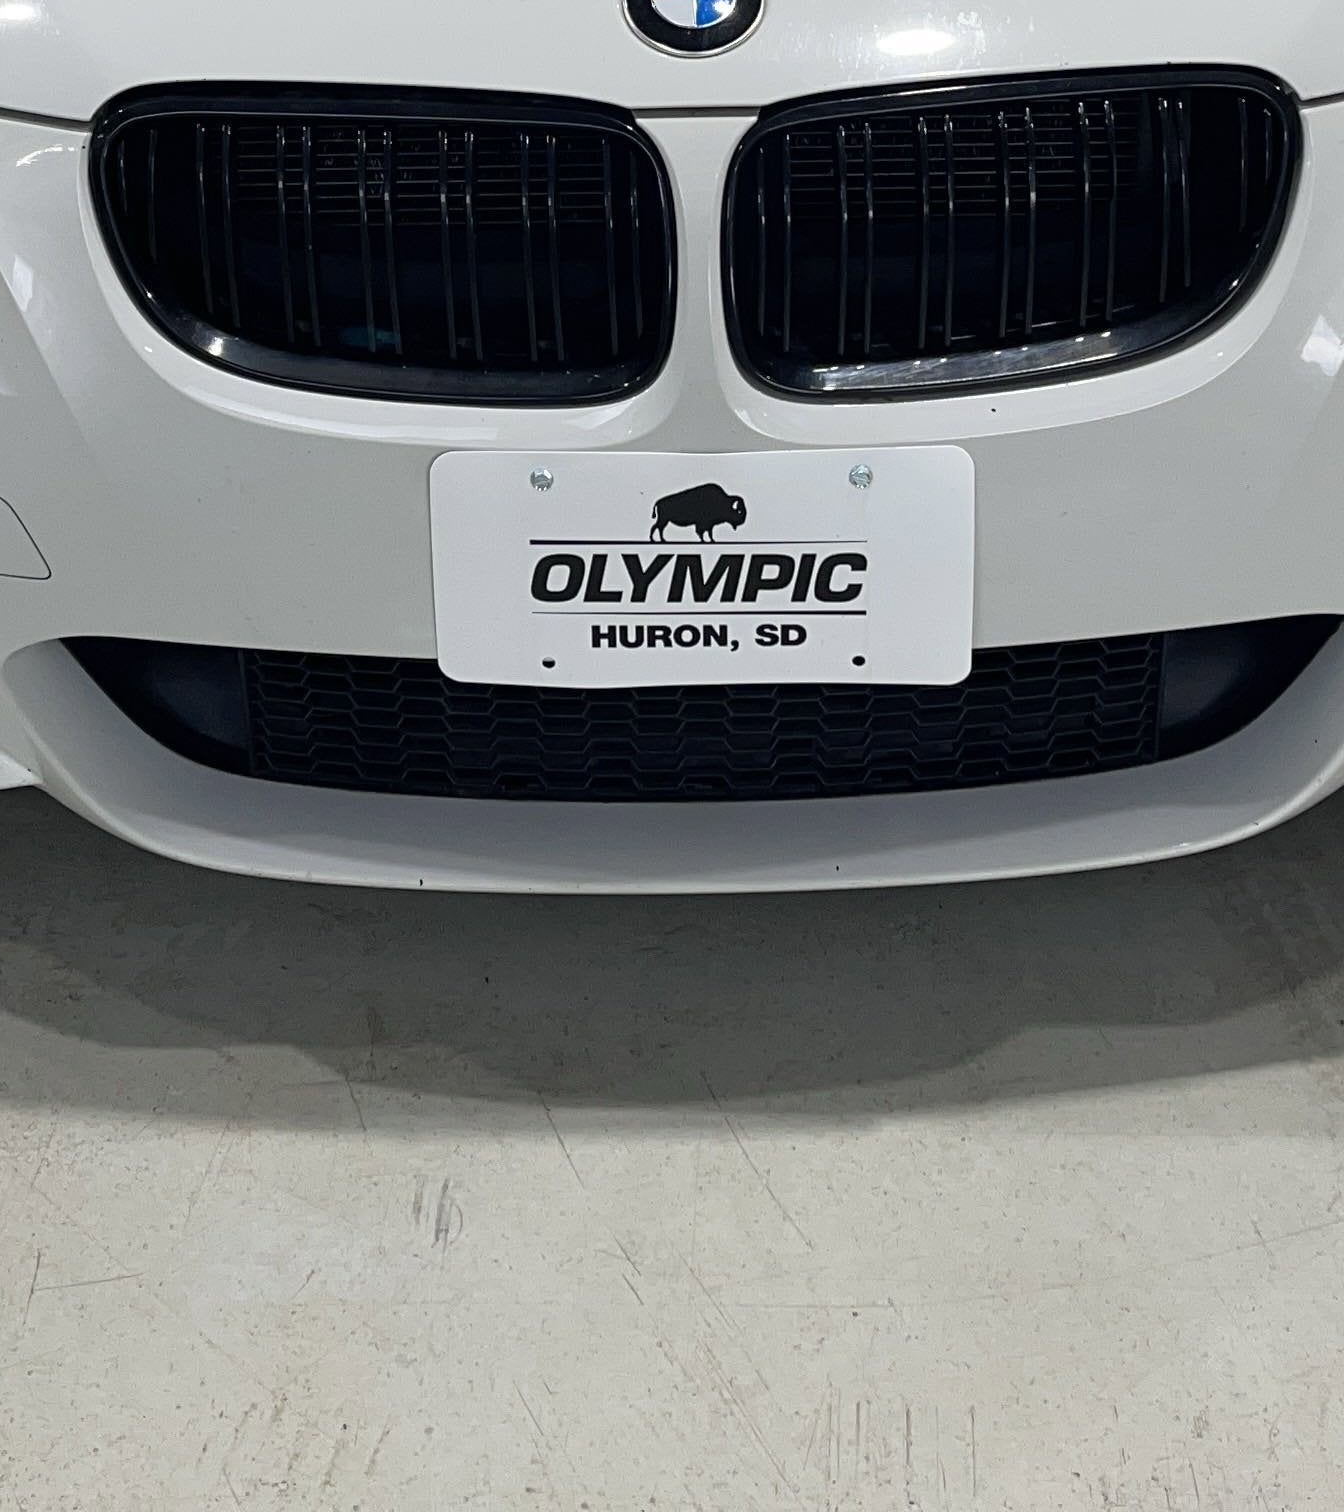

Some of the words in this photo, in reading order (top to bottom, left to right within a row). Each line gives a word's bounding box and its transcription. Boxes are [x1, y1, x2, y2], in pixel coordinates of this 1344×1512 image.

[529, 552, 868, 603] OLYMPIC
[591, 623, 740, 651] HURON,
[755, 624, 807, 647] SD
